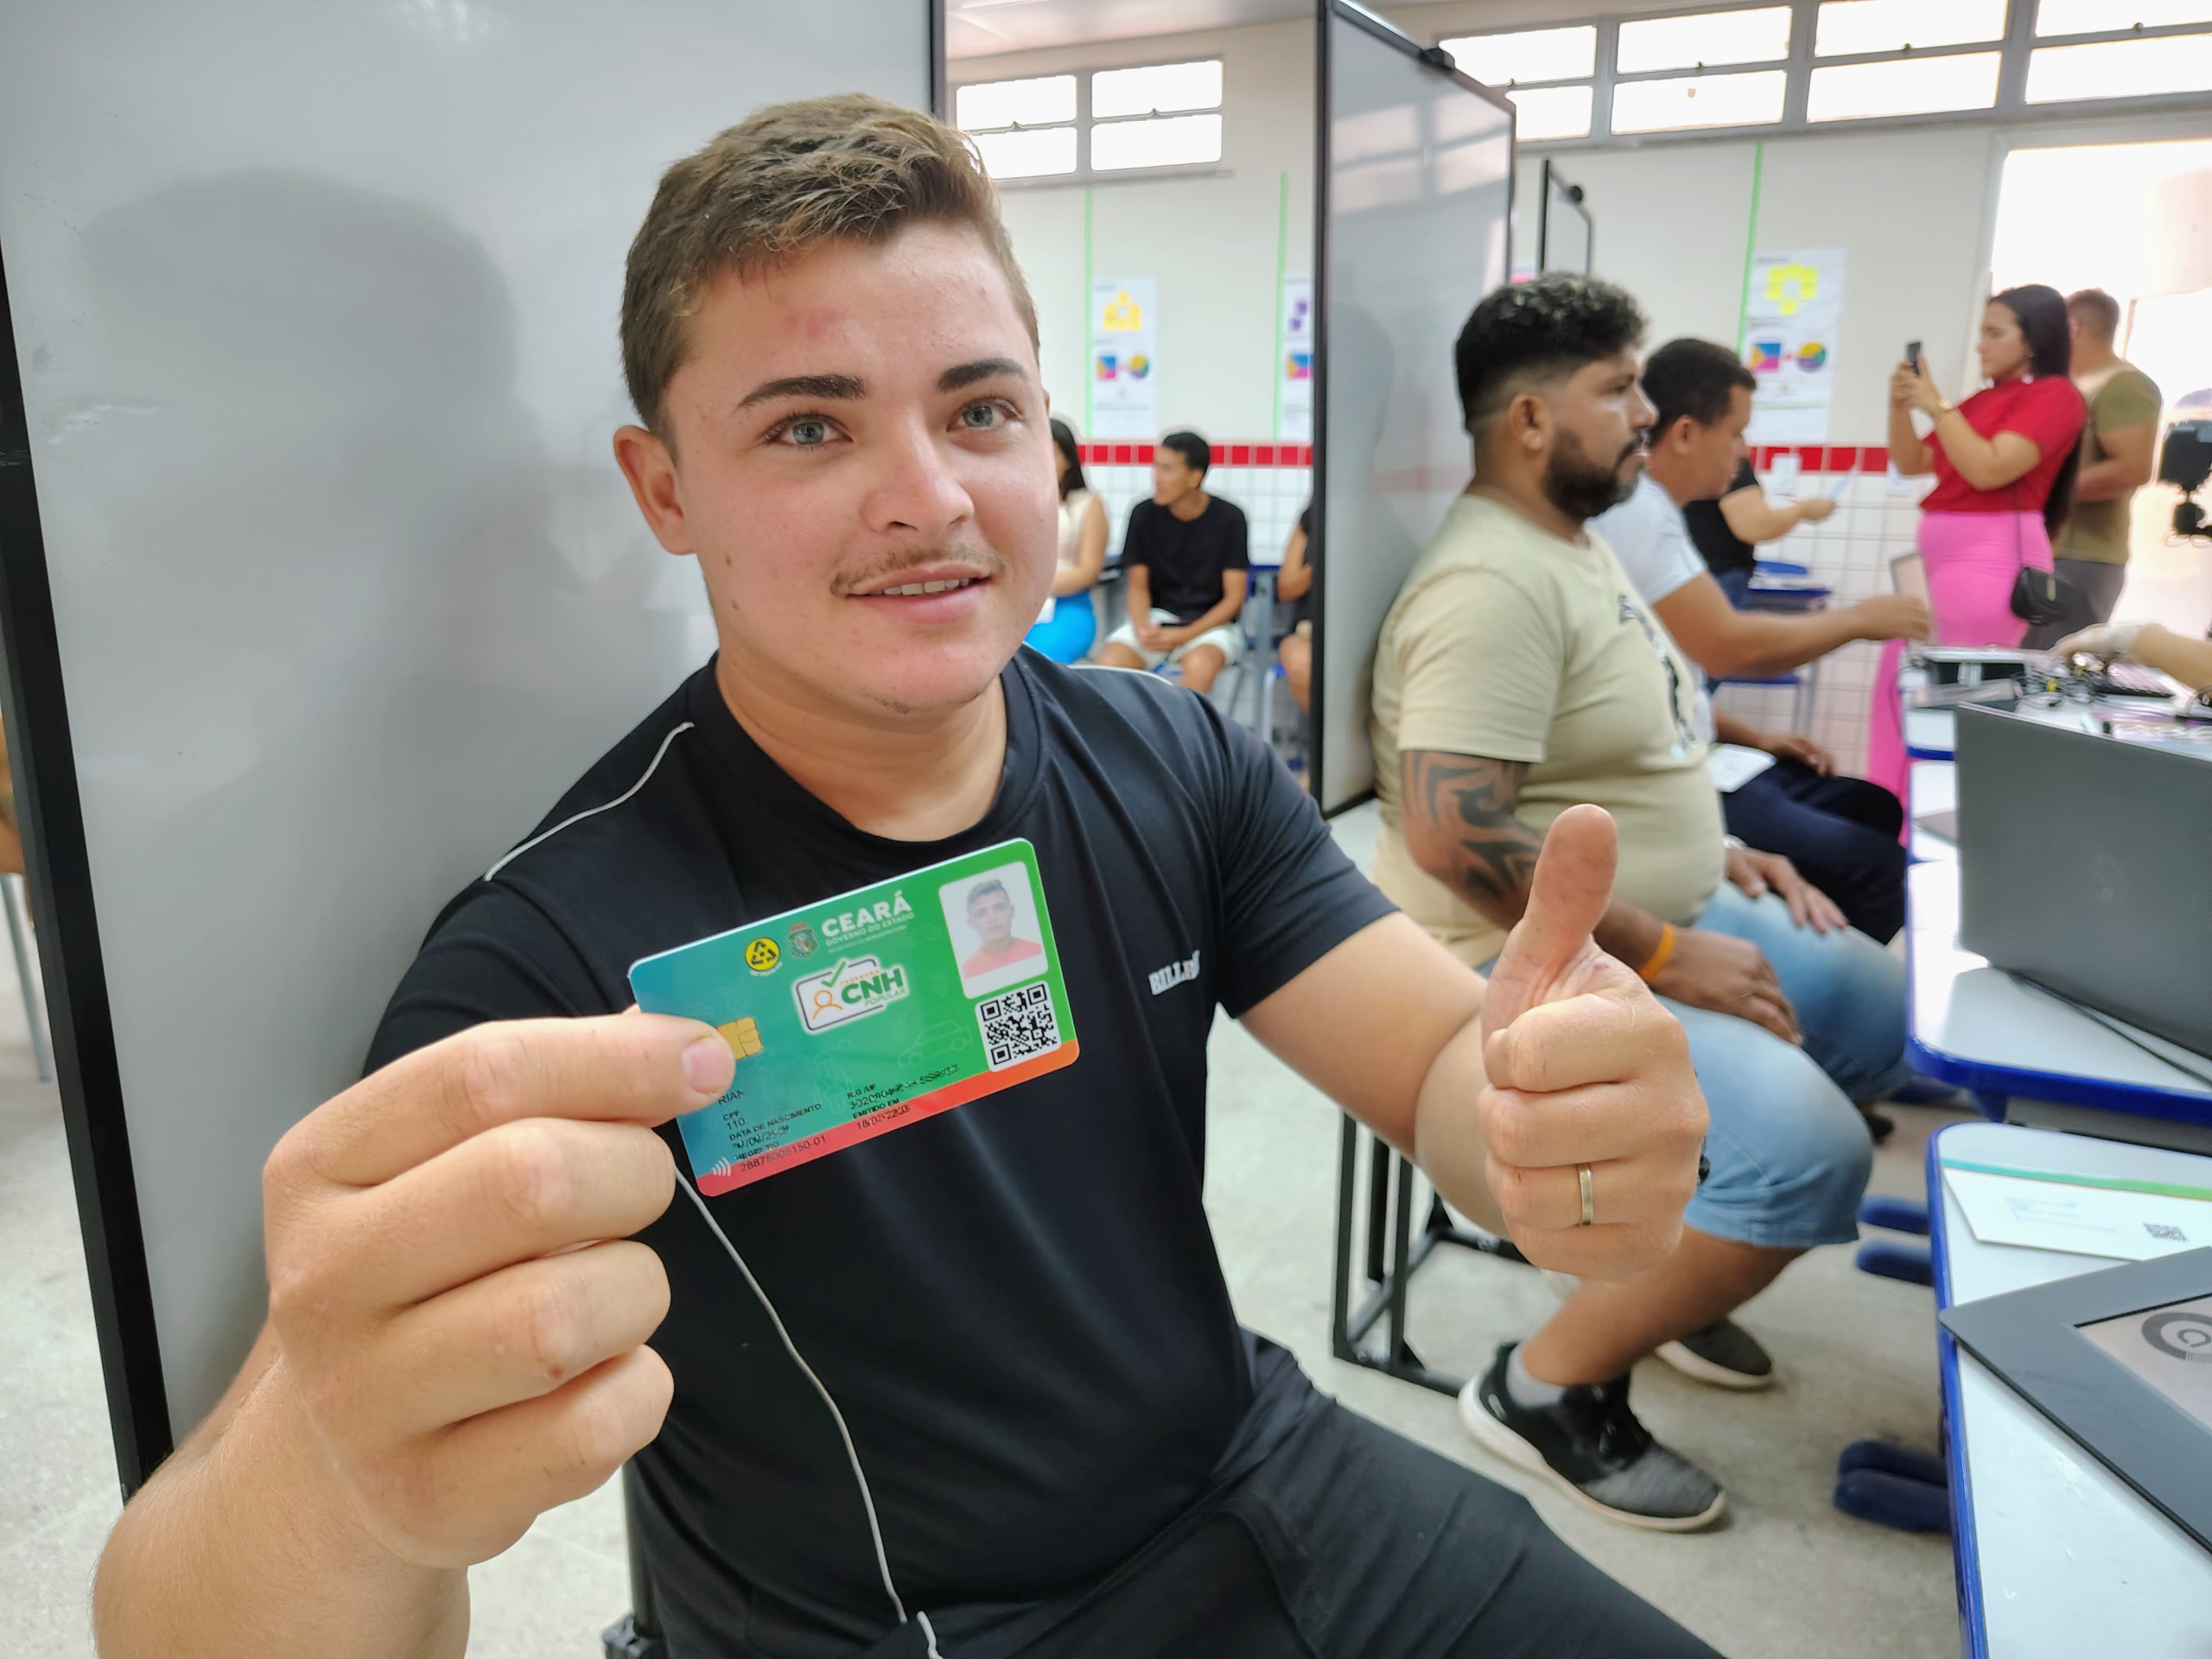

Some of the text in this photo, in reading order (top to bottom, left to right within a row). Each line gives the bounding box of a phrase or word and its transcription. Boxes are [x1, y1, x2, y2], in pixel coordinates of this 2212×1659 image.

[822, 890, 912, 937] CEARÁ
[825, 912, 915, 946] GOVERNO DO ESTADO
[841, 968, 904, 1005] CNH
[864, 988, 906, 1007] POPULAR
[723, 1109, 741, 1121] CPF
[729, 1128, 752, 1141] DATA
[753, 1122, 766, 1133] DE
[766, 1103, 822, 1127] NASCIMENTO
[852, 1098, 900, 1119] EMITIDO EM
